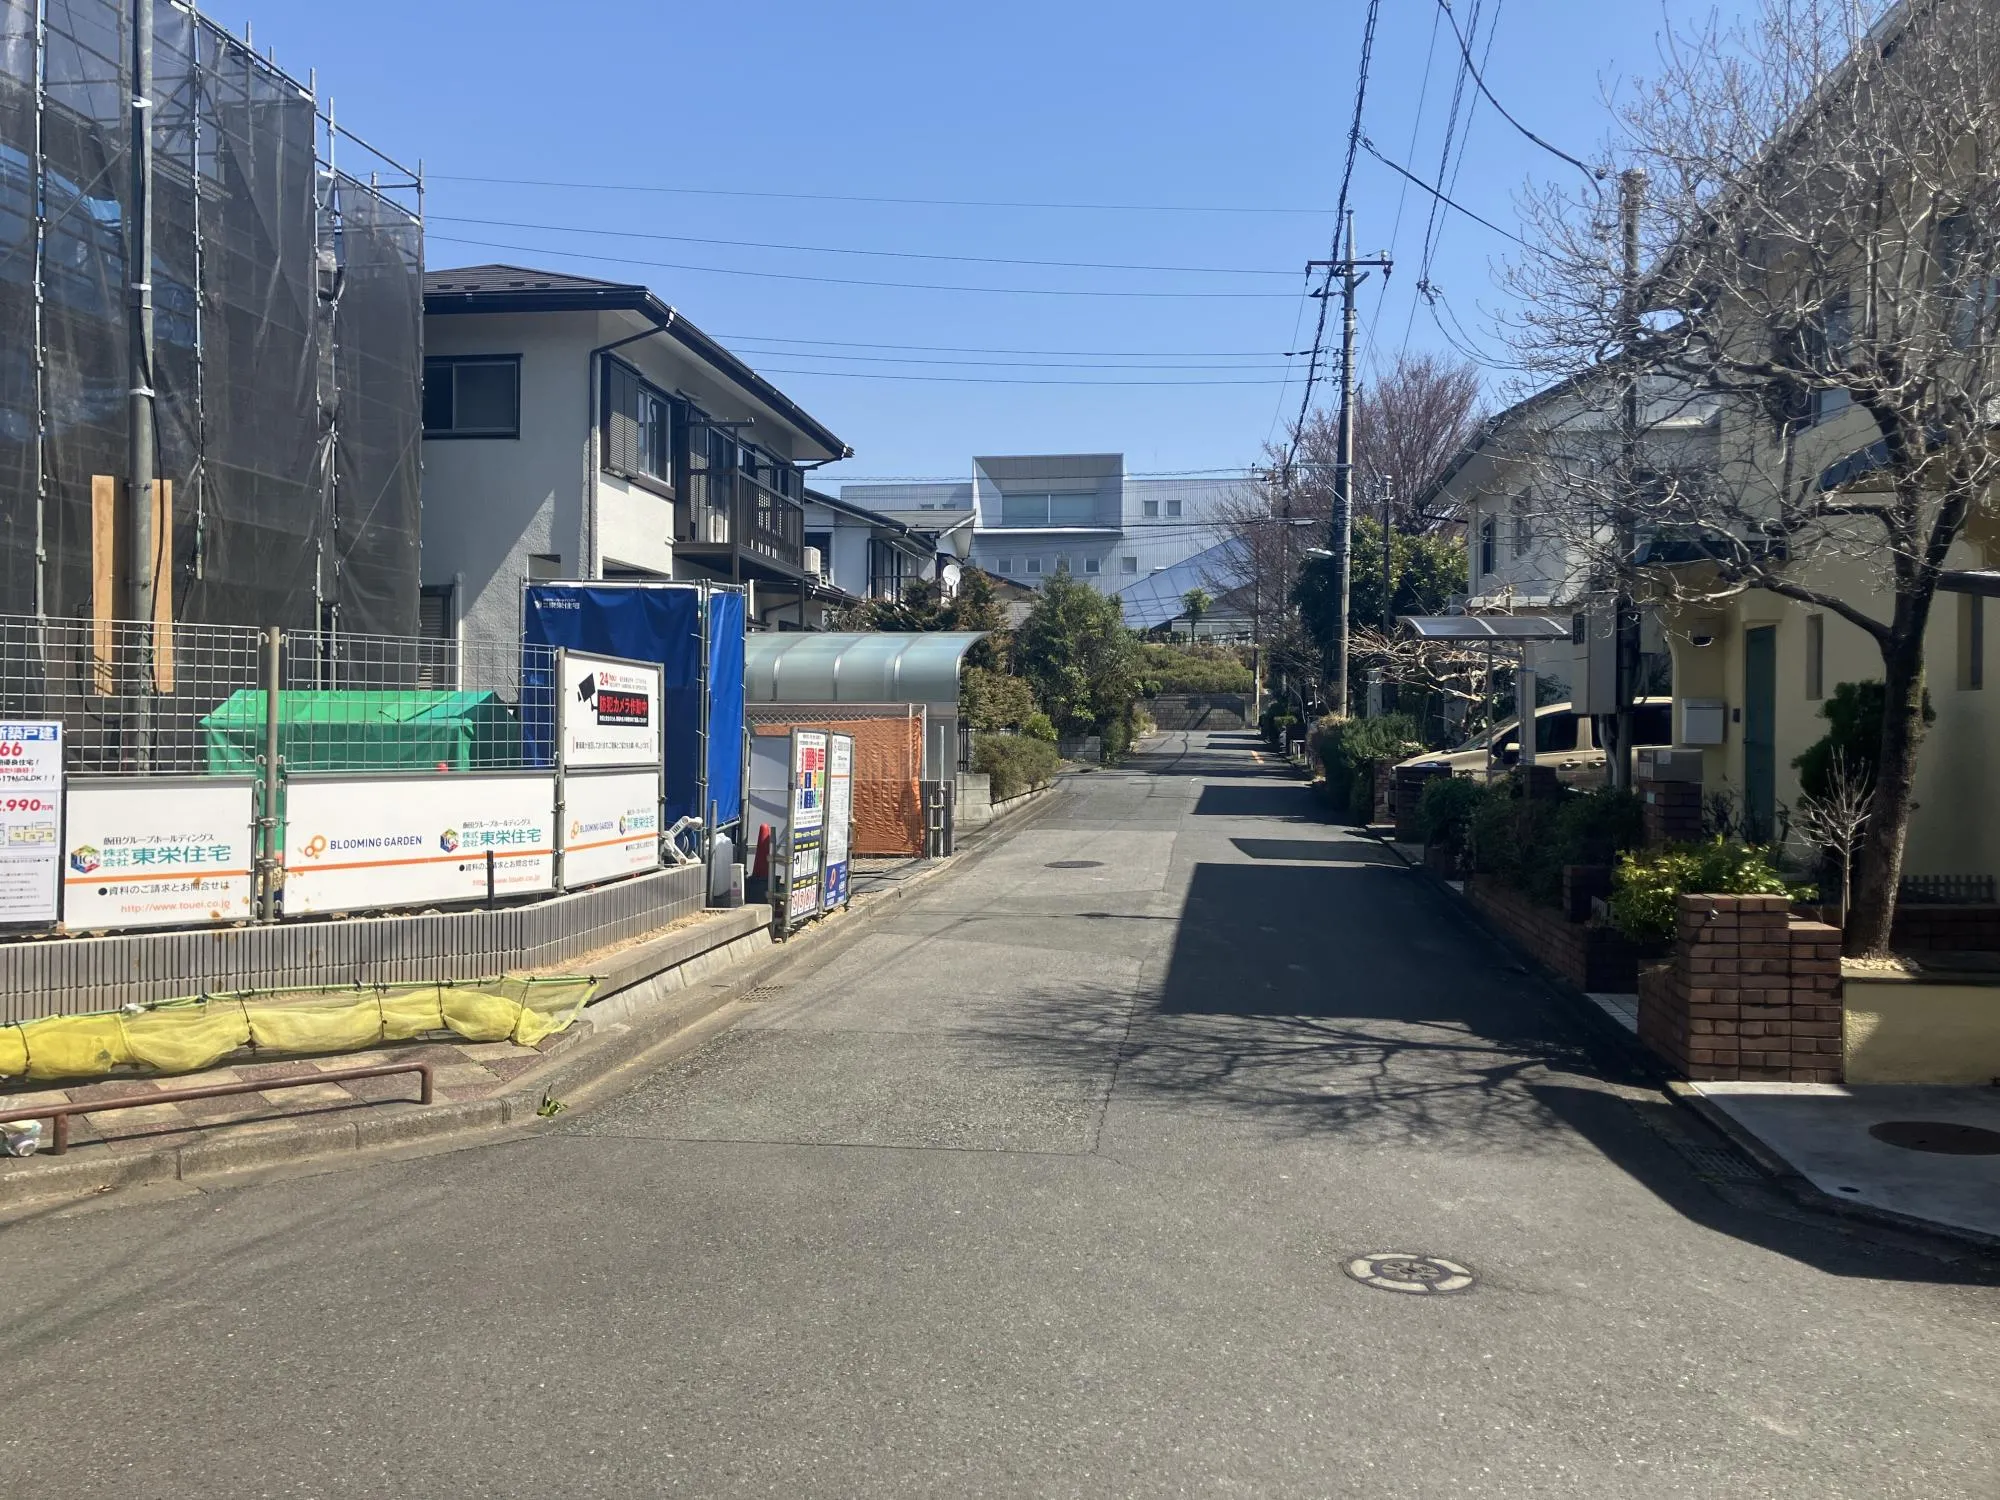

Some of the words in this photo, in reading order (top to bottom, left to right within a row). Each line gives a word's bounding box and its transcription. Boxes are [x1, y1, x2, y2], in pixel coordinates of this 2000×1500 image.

[103, 833, 214, 846] 飯田グループホールディングス
[330, 836, 382, 850] BLOOMING
[384, 835, 423, 848] GARDEN
[480, 829, 541, 845] 東栄住宅
[131, 845, 231, 865] 東栄住宅
